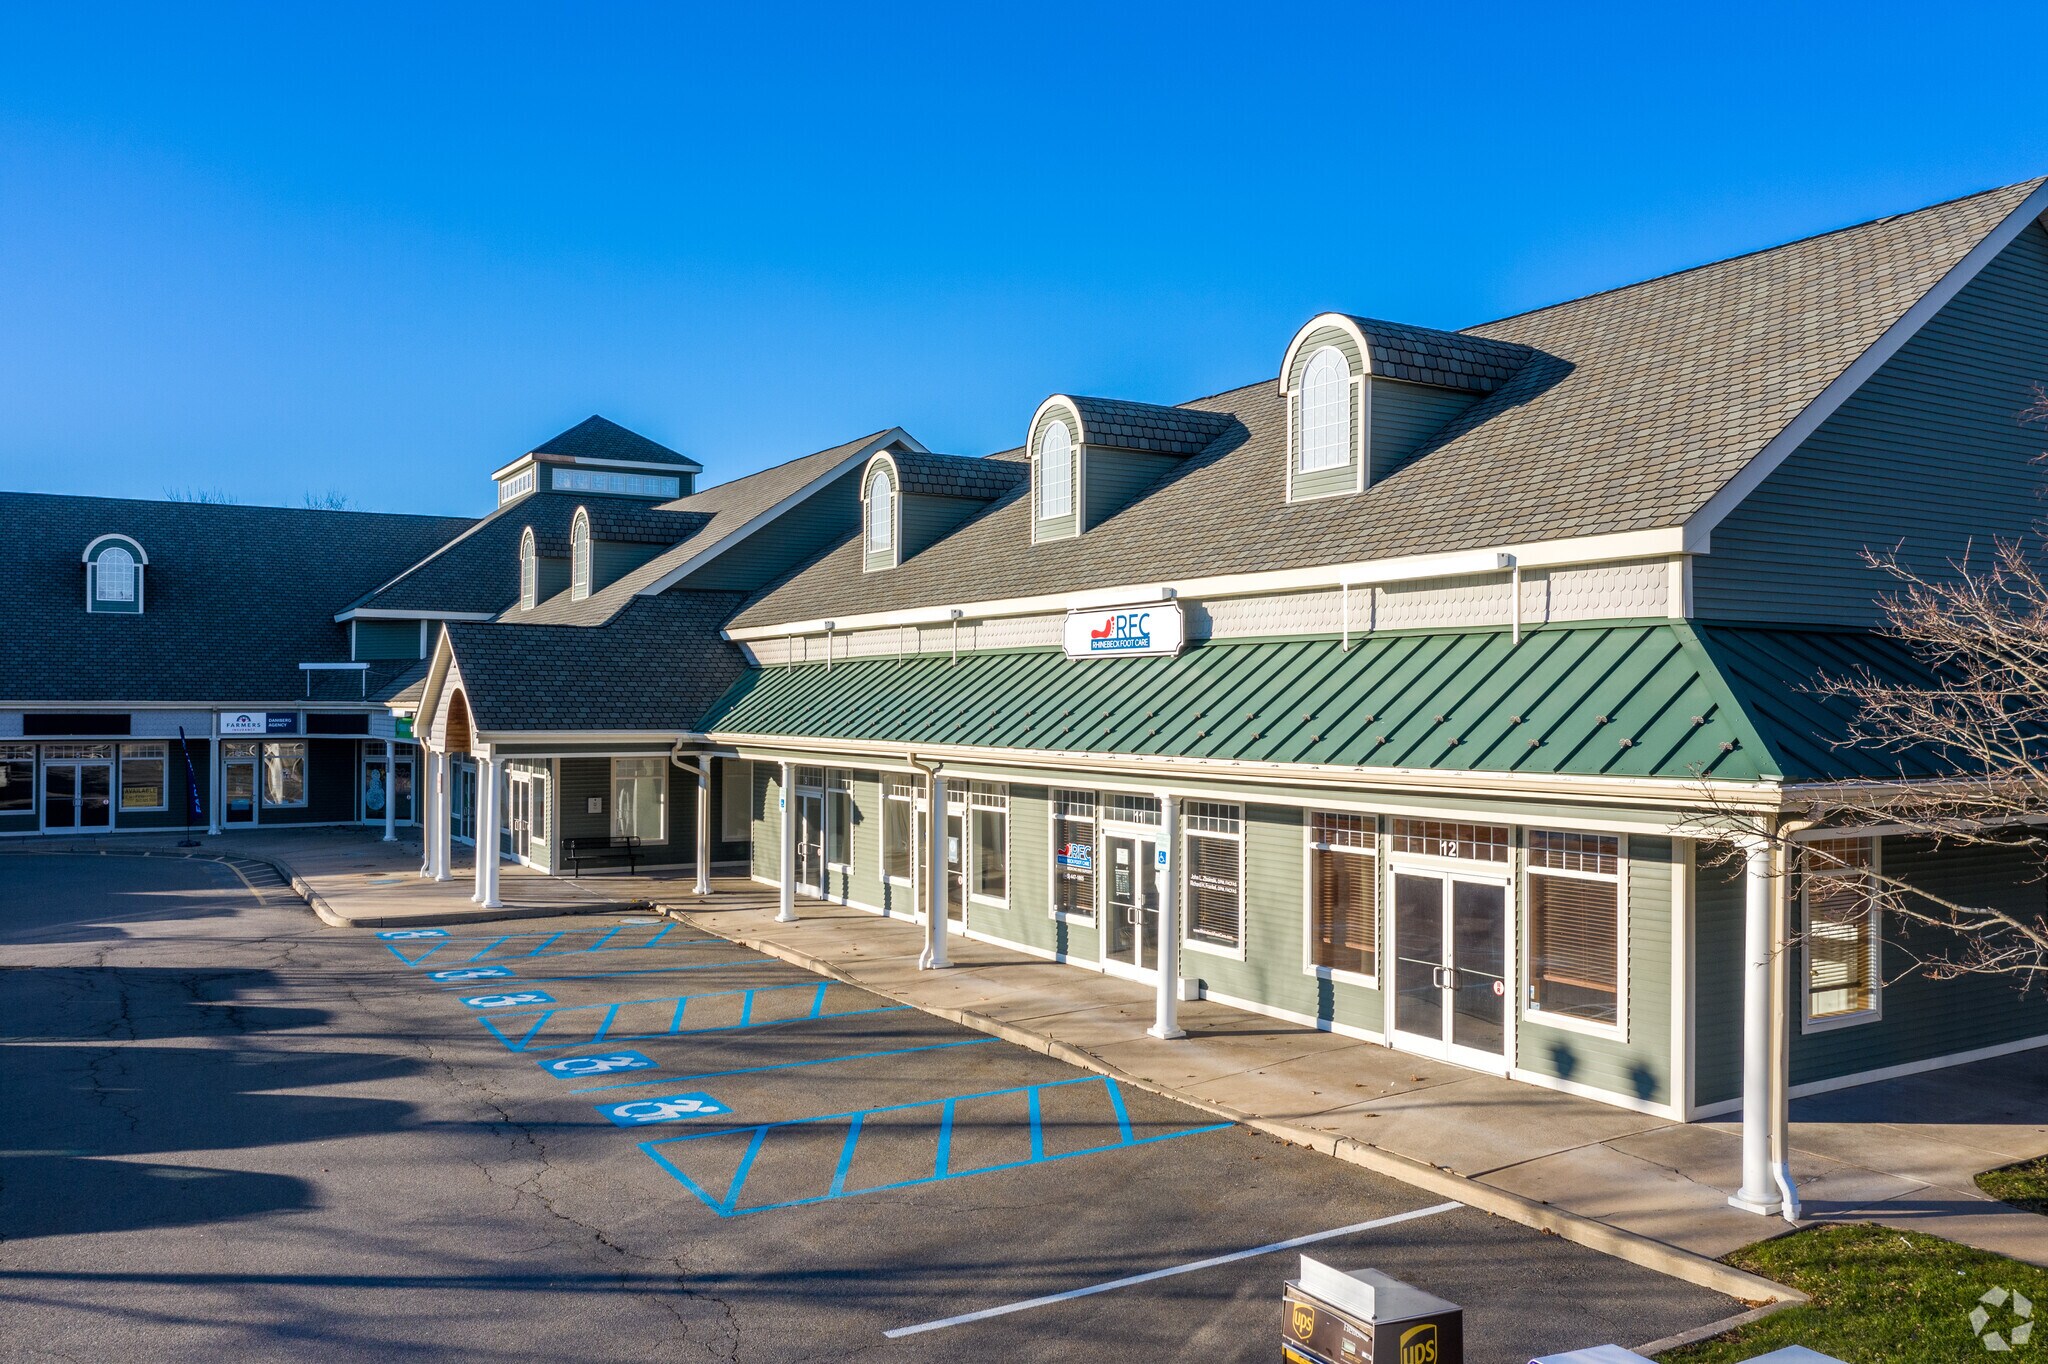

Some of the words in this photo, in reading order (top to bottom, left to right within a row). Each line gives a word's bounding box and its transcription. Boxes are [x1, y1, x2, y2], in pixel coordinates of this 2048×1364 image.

[1116, 613, 1150, 638] RFC
[1092, 640, 1120, 649] RHINEBECK
[1120, 639, 1134, 648] FOOT
[1135, 638, 1149, 647] CARE
[1134, 811, 1143, 824] 11
[1071, 844, 1092, 860] RFC
[1441, 841, 1457, 857] 12
[1295, 1311, 1312, 1333] ups
[1404, 1340, 1435, 1364] ups
